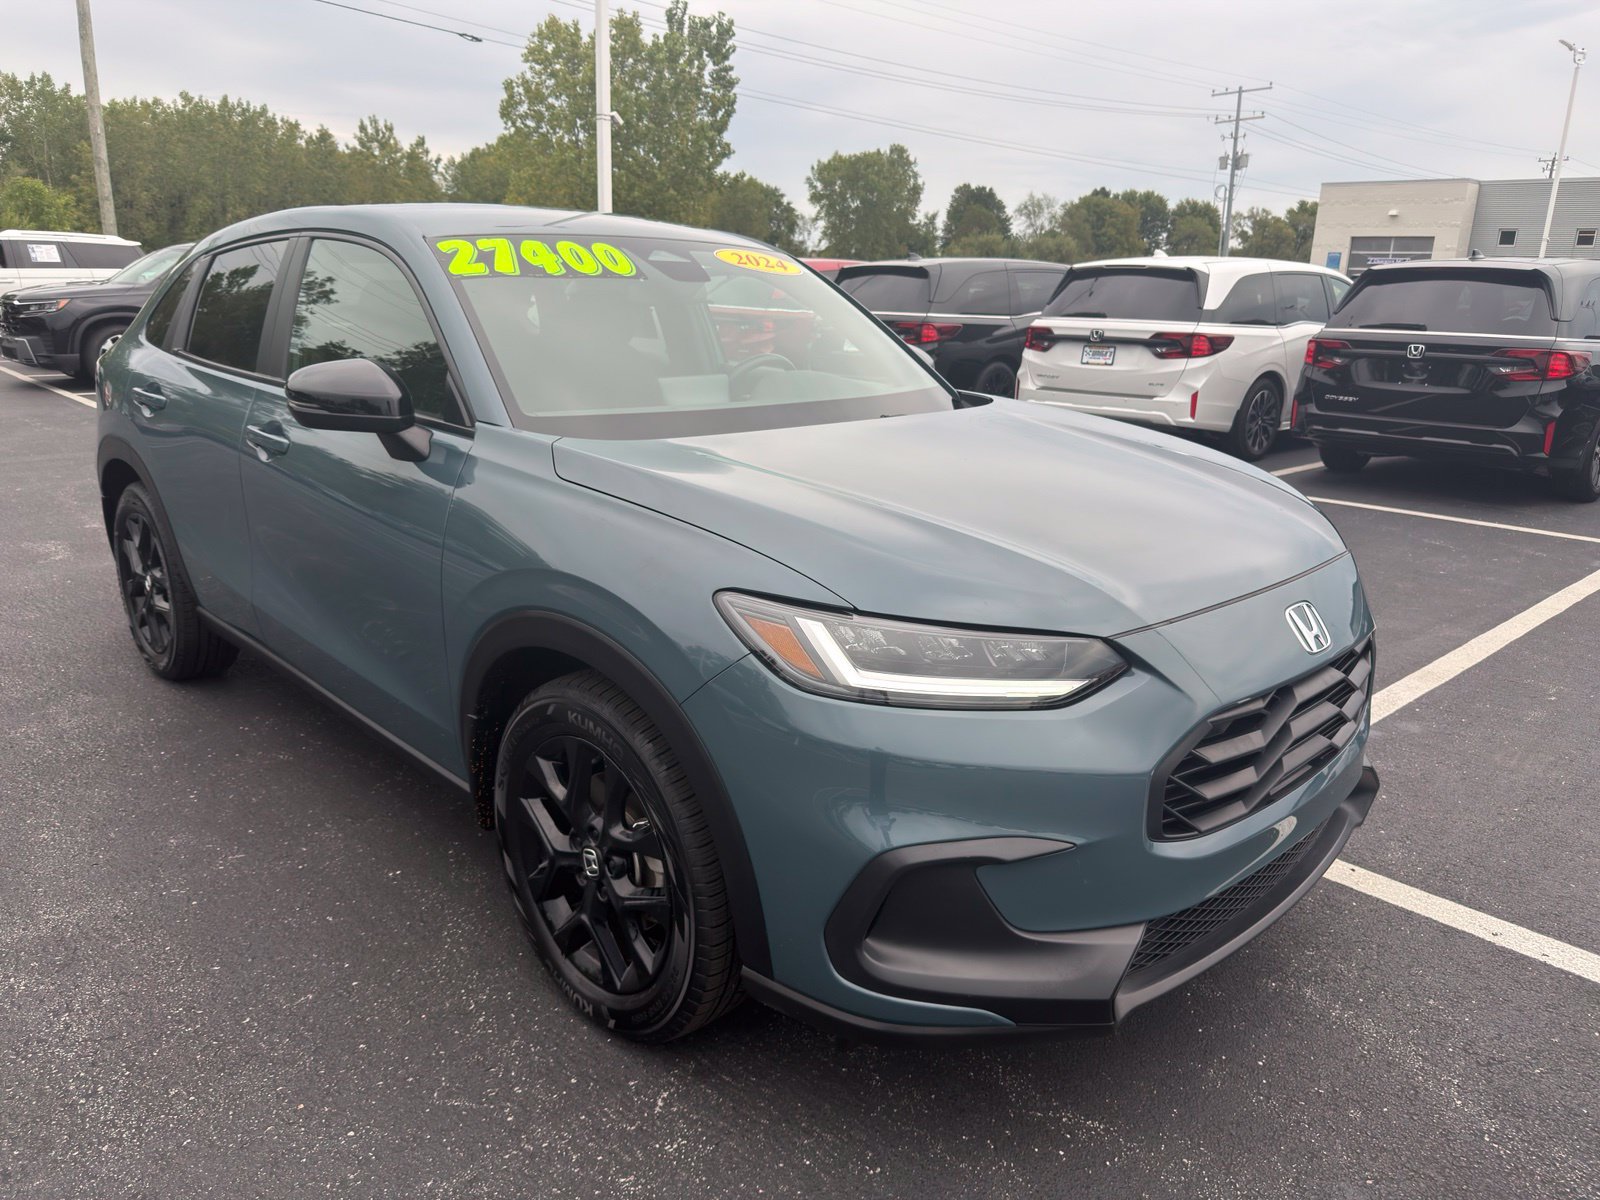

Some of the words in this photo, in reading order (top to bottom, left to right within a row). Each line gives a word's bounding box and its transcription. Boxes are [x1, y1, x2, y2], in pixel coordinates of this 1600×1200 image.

[436, 238, 637, 277] 27400
[730, 252, 788, 271] 2024
[567, 710, 624, 760] KUMHO
